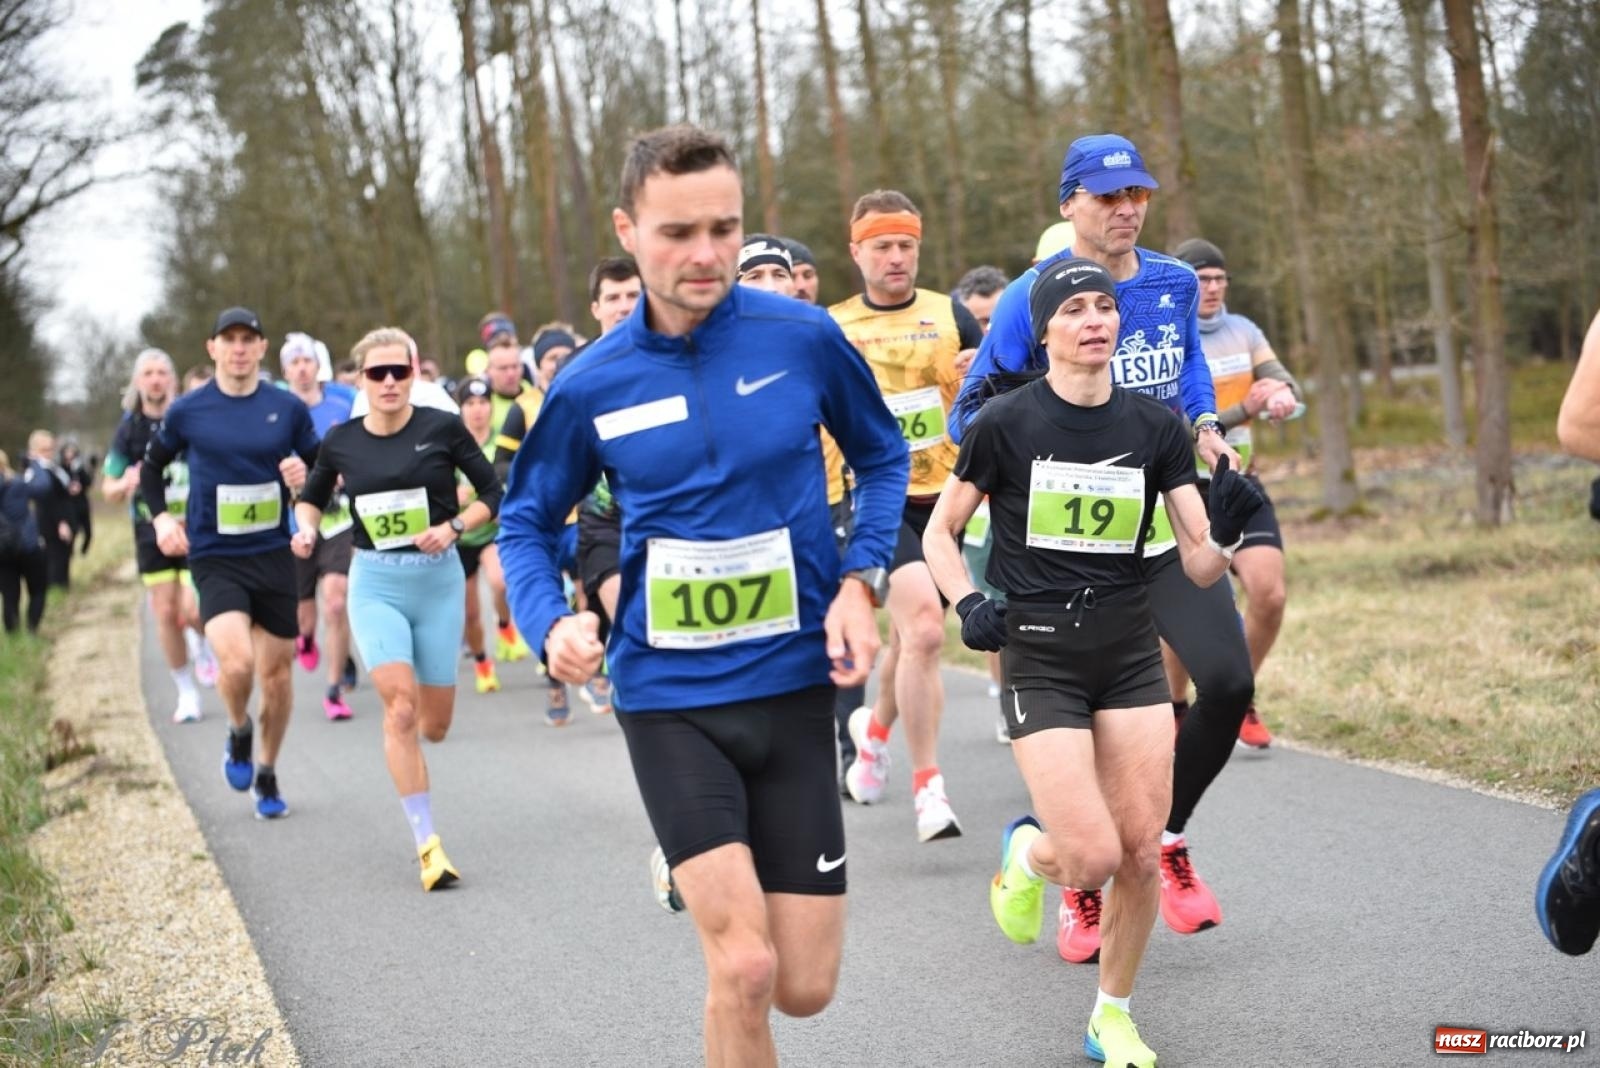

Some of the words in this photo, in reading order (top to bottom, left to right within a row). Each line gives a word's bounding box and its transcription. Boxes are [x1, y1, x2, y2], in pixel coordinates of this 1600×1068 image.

[243, 503, 257, 523] 4
[374, 511, 408, 538] 35
[1064, 496, 1115, 536] 19
[670, 574, 772, 628] 107
